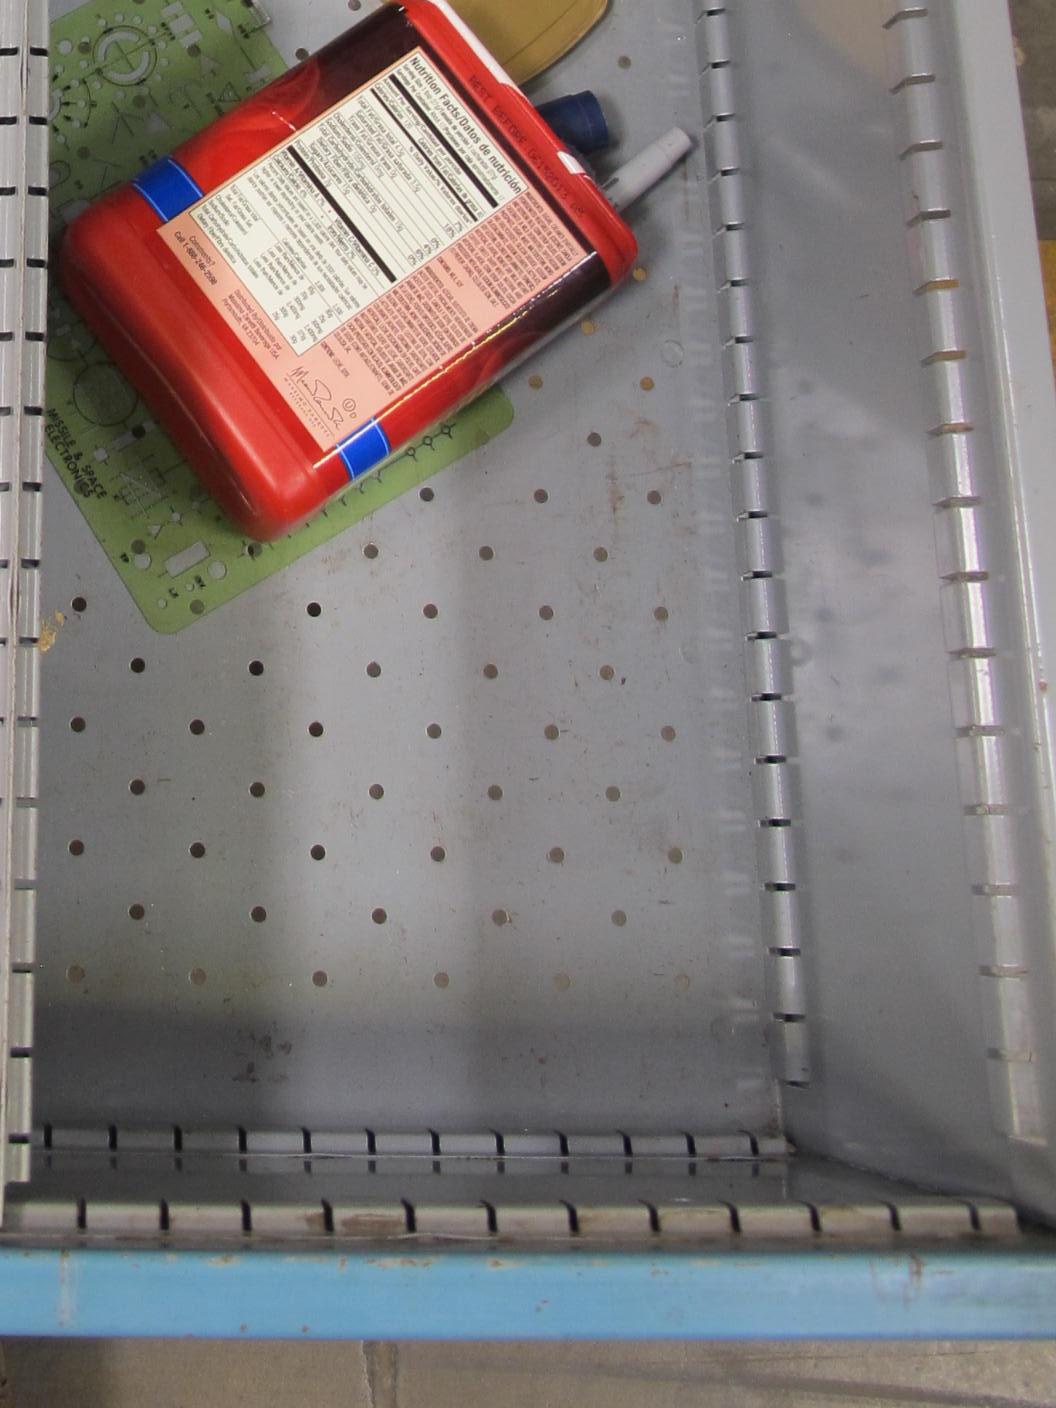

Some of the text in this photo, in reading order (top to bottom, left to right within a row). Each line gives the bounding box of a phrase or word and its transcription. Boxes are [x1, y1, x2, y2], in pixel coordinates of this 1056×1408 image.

[409, 56, 522, 195] Nutrition Facts/Datos de nutrición
[172, 230, 185, 244] Call
[44, 424, 94, 498] ELECTRONICS
[45, 407, 108, 499] MISSILE & SPACE
